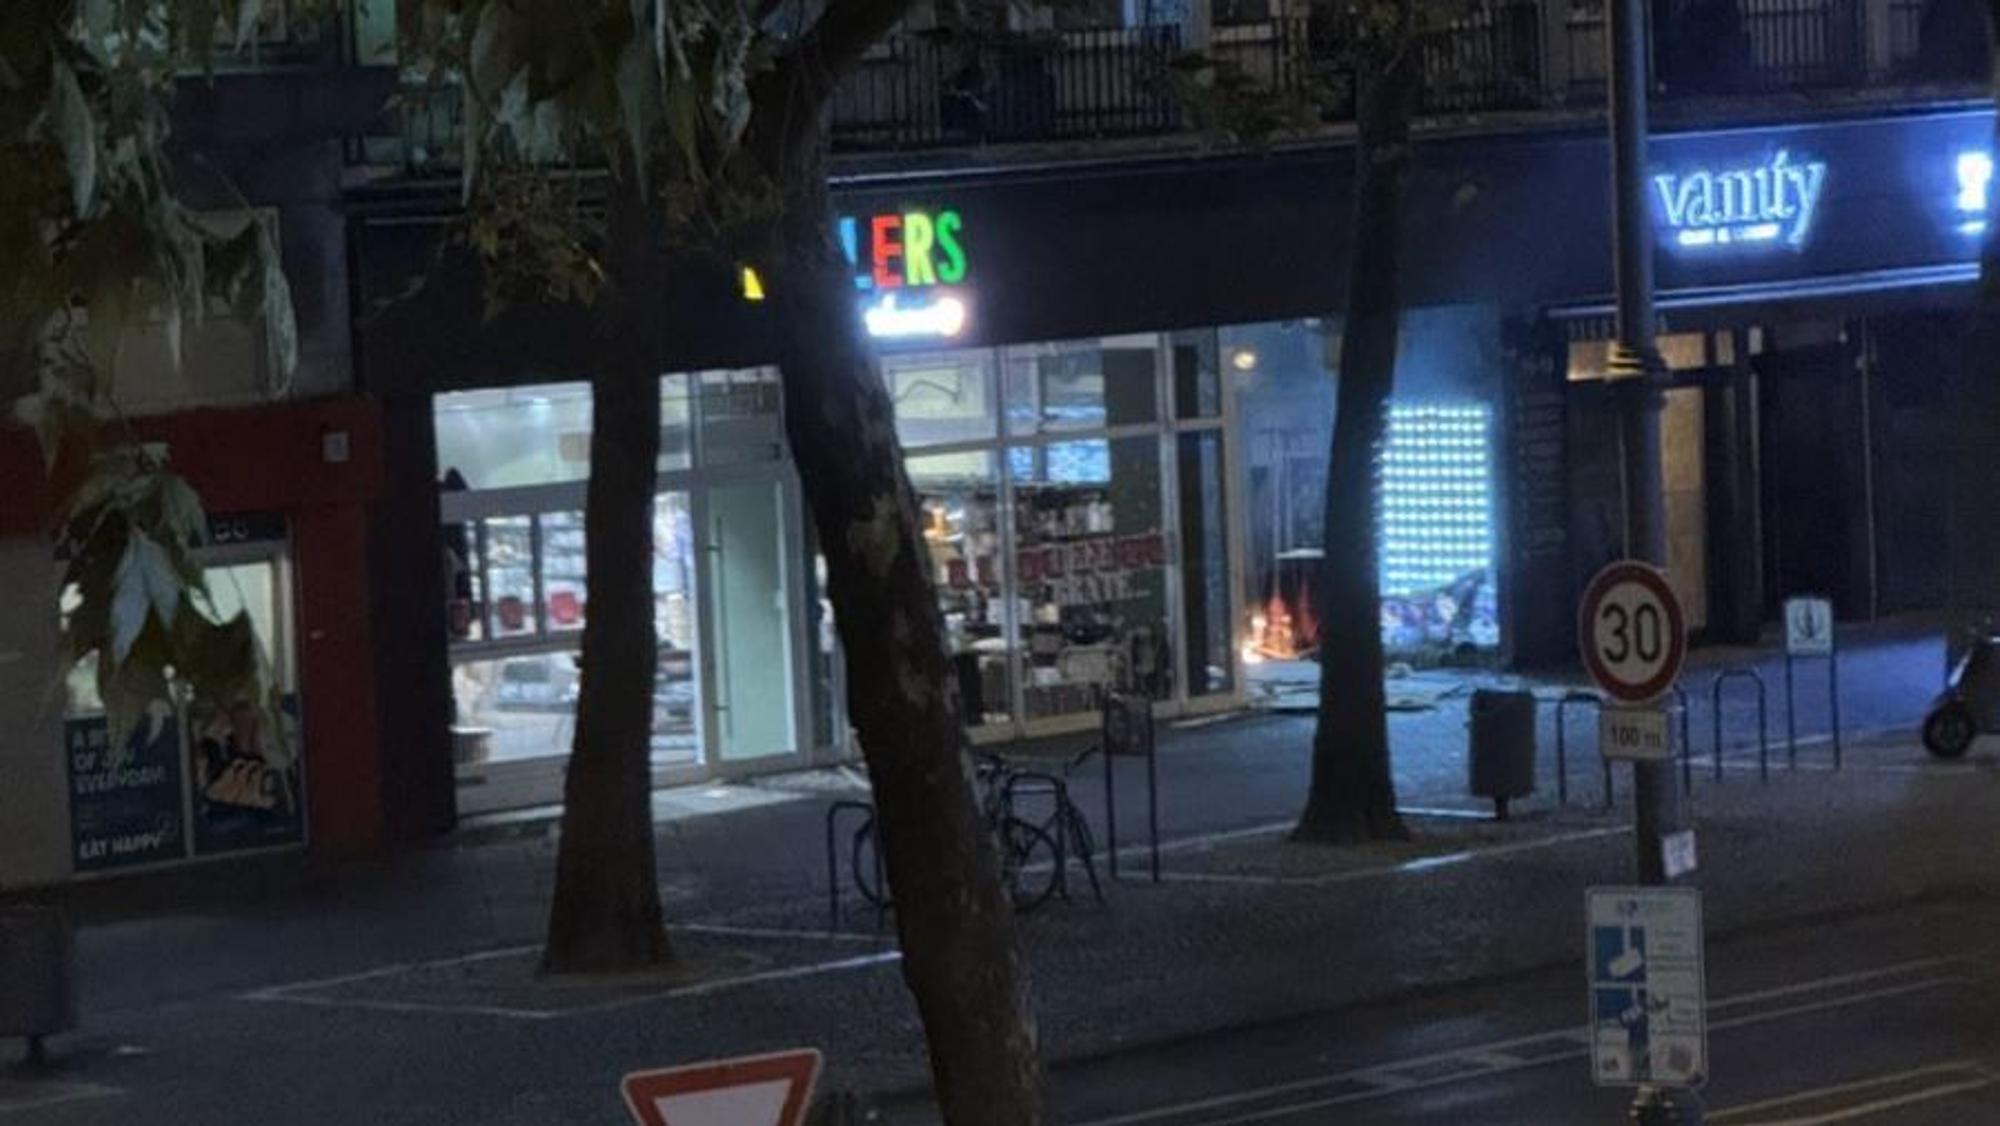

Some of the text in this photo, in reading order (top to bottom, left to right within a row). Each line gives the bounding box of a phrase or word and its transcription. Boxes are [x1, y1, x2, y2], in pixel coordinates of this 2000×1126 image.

[1602, 603, 1661, 664] 30
[1611, 726, 1661, 746] 100 m
